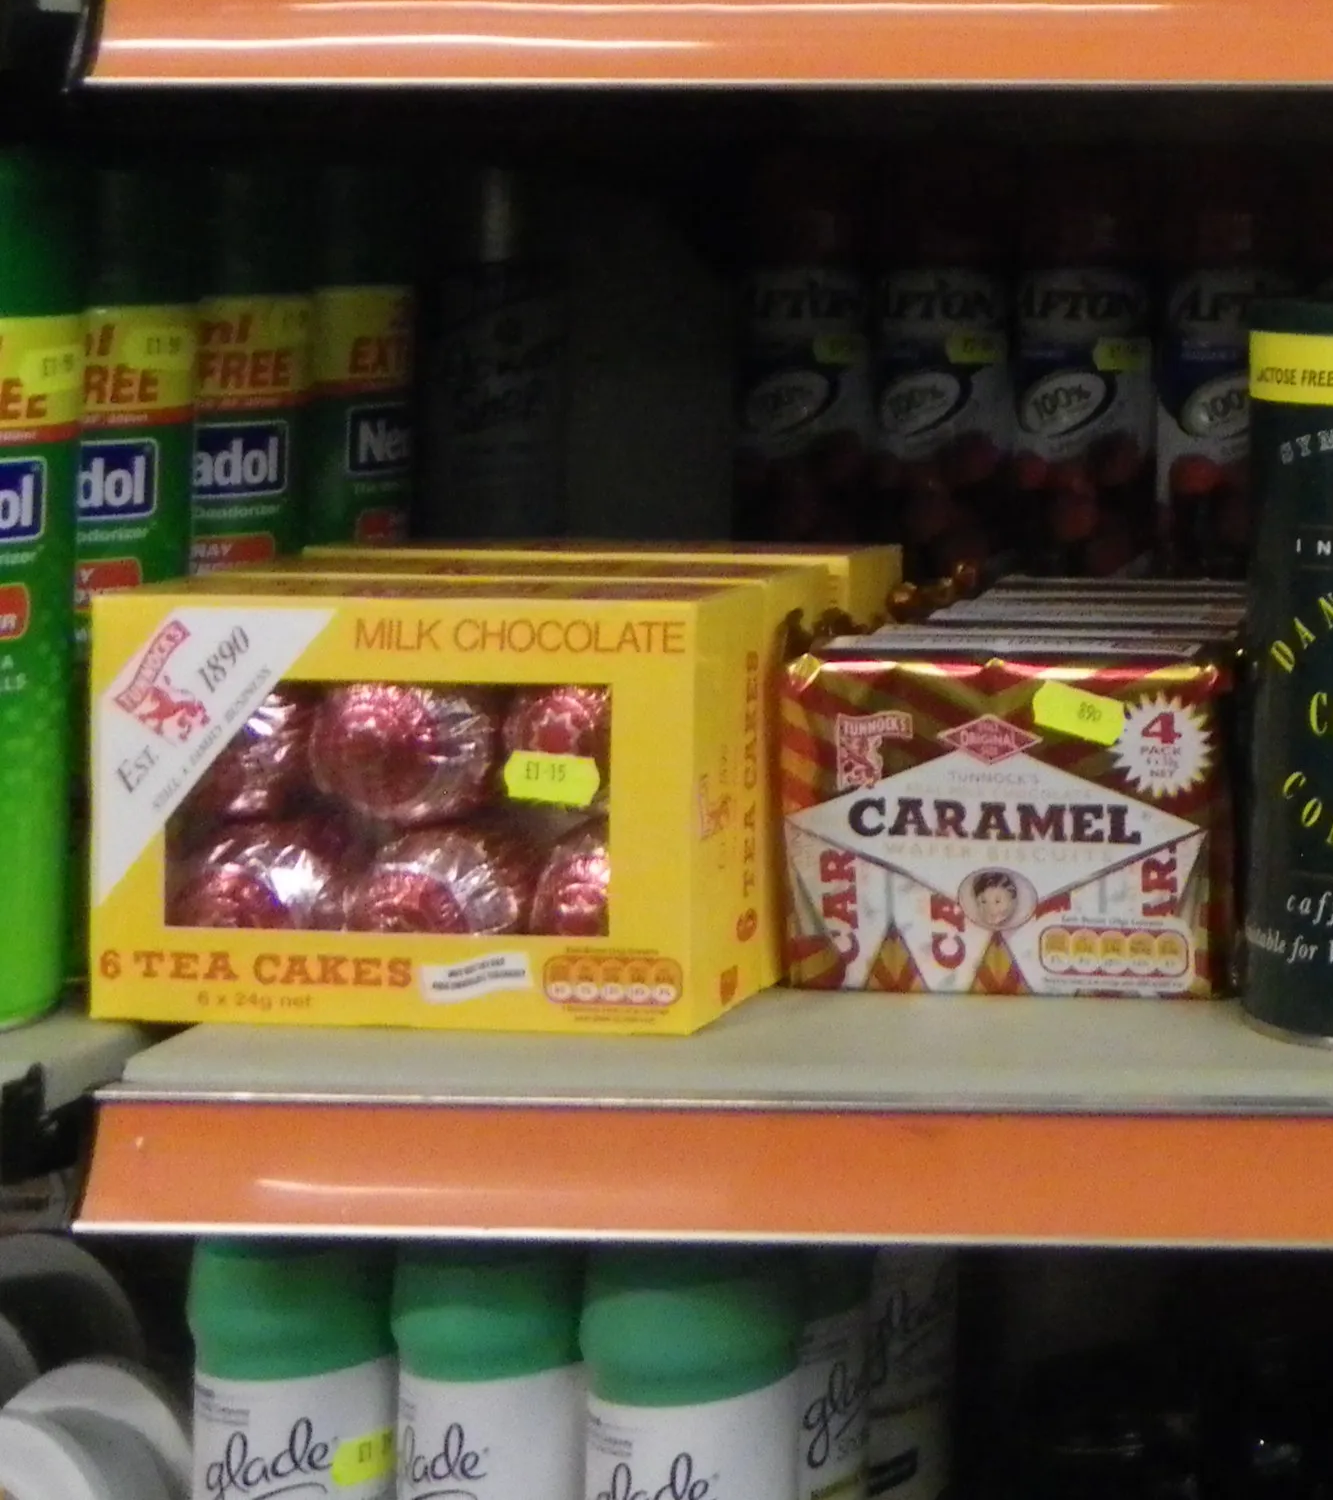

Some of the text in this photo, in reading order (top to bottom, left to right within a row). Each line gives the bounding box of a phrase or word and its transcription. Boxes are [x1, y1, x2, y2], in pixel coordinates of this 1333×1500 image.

[353, 617, 687, 655] MILK CHOCOLATE
[197, 625, 250, 694] 1890
[1141, 711, 1182, 745] 4
[848, 795, 1142, 845] CARAMEL
[99, 954, 122, 980] 6
[133, 953, 237, 983] TEA
[252, 954, 414, 987] CAKES
[1287, 936, 1318, 964] for
[204, 1417, 332, 1500] glade
[403, 1422, 487, 1484] lade
